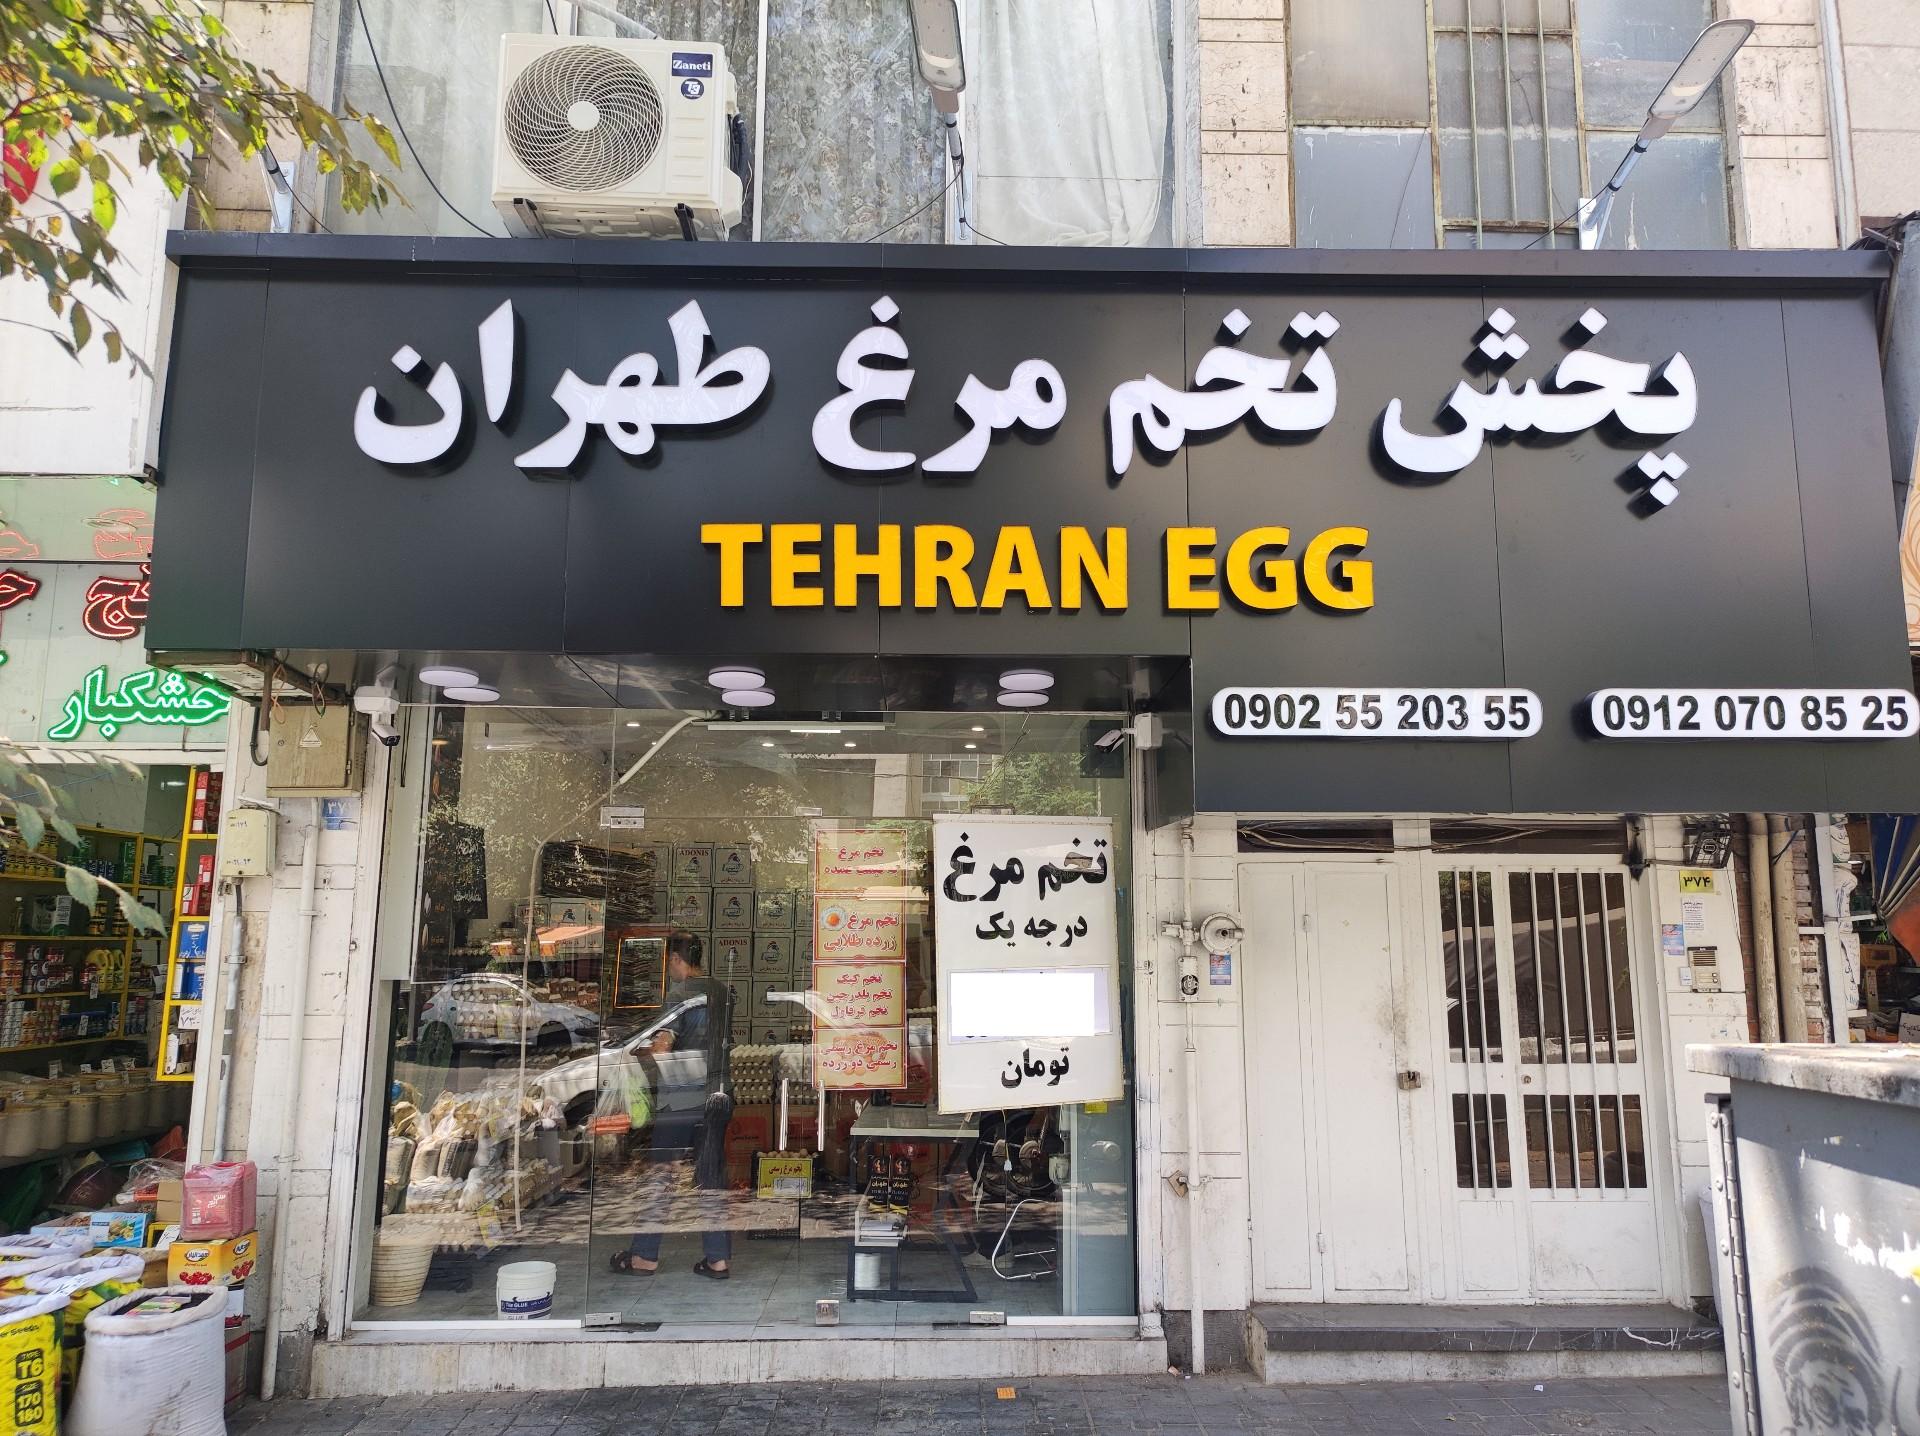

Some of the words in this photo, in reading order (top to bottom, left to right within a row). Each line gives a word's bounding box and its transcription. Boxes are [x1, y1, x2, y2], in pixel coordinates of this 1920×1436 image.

[672, 59, 711, 71] Zaneti
[353, 298, 771, 468] طهران
[811, 295, 1068, 472] مرغ
[1108, 307, 1341, 475] تخم
[1382, 306, 1698, 507] پخش
[700, 523, 1129, 610] TEHRAN
[1166, 525, 1376, 611] EGG
[48, 664, 232, 742] خشکبار
[1224, 693, 1322, 730] 0902
[1335, 694, 1384, 730] 55
[1397, 694, 1470, 731] 203
[1484, 695, 1531, 731] 55
[1603, 695, 1701, 731] 0912
[1714, 695, 1786, 731] 070
[1800, 695, 1848, 731] 85
[1860, 695, 1909, 731] 25
[680, 849, 709, 857] ADONIS
[838, 846, 861, 862] مرغ
[942, 831, 1025, 902] مرغ
[1037, 837, 1108, 901] تخم
[1683, 875, 1711, 888] ۳۷۴
[847, 912, 873, 930] مرغ
[875, 913, 900, 931] تخم
[976, 910, 1015, 948] یک
[1023, 914, 1088, 948] درجه
[863, 973, 882, 988] تخم
[872, 988, 893, 1004] تخم
[868, 1005, 889, 1020] تخم
[1000, 1046, 1070, 1089] تومان
[17, 1357, 44, 1379] T6
[16, 1391, 42, 1409] 170
